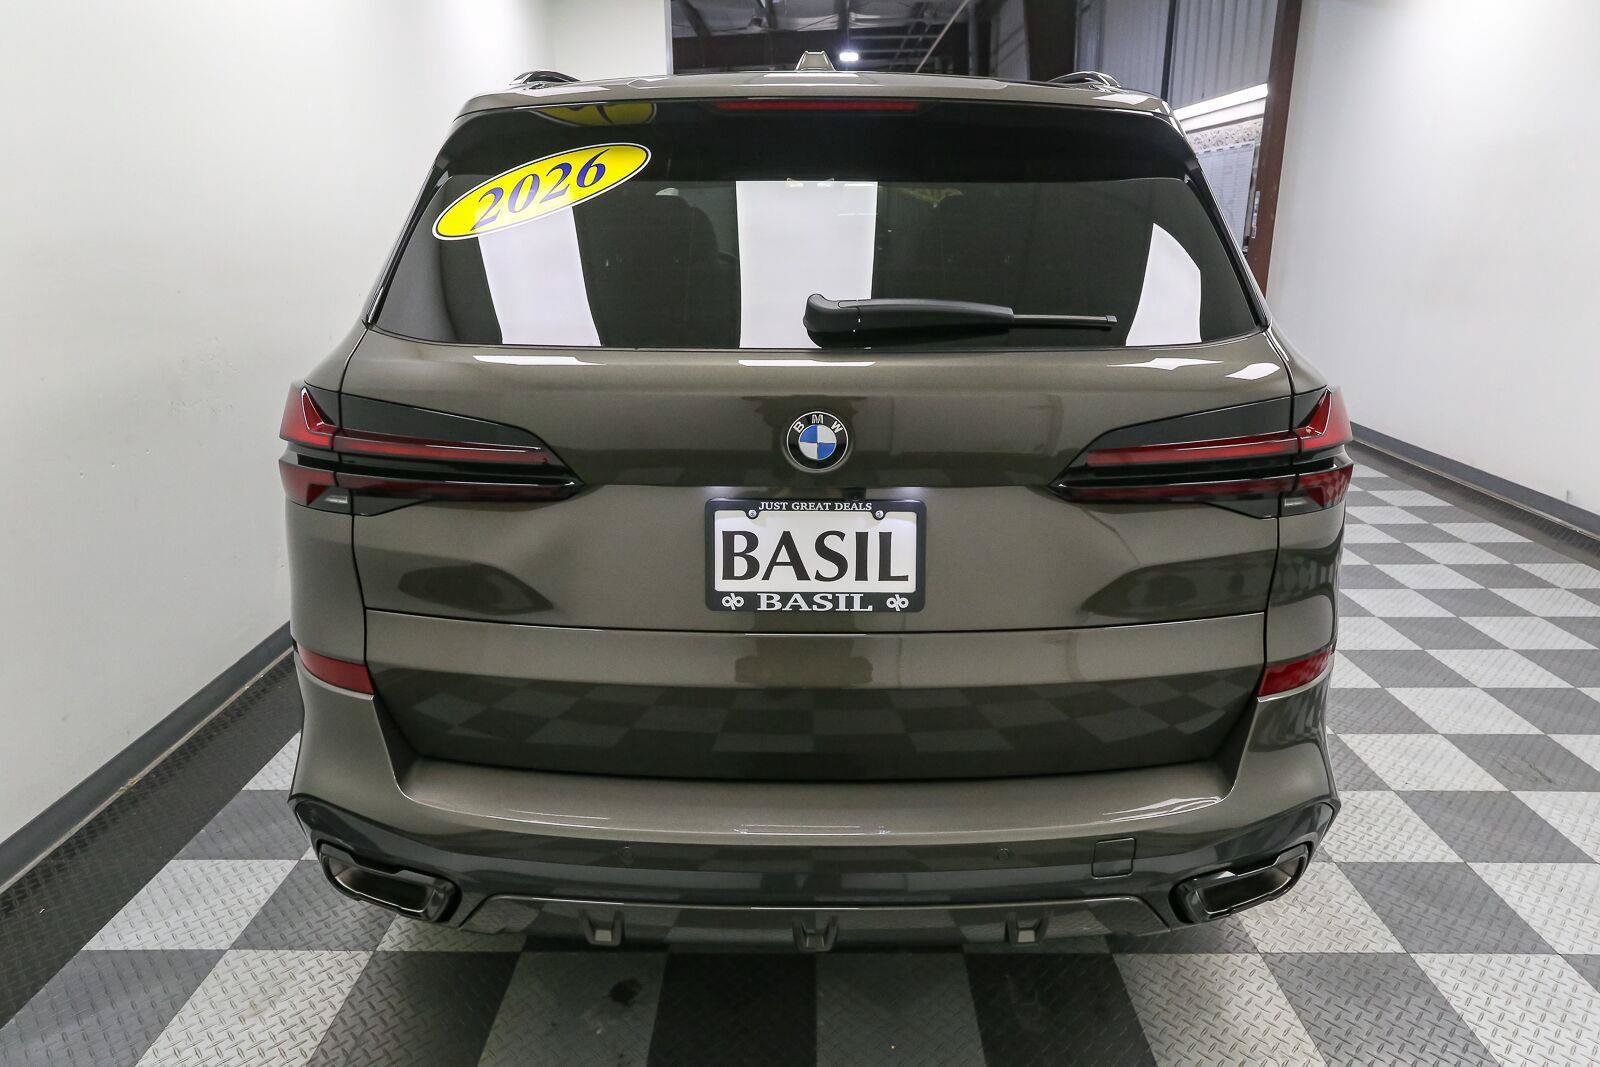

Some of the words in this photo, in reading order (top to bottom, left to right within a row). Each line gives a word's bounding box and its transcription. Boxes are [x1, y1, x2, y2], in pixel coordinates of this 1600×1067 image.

[469, 148, 610, 231] 2026
[793, 414, 843, 434] BMW
[758, 501, 788, 511] JUST
[791, 502, 832, 511] GREAT
[834, 502, 873, 511] DEALS
[722, 530, 909, 582] BASIL
[756, 593, 873, 612] BASIL
